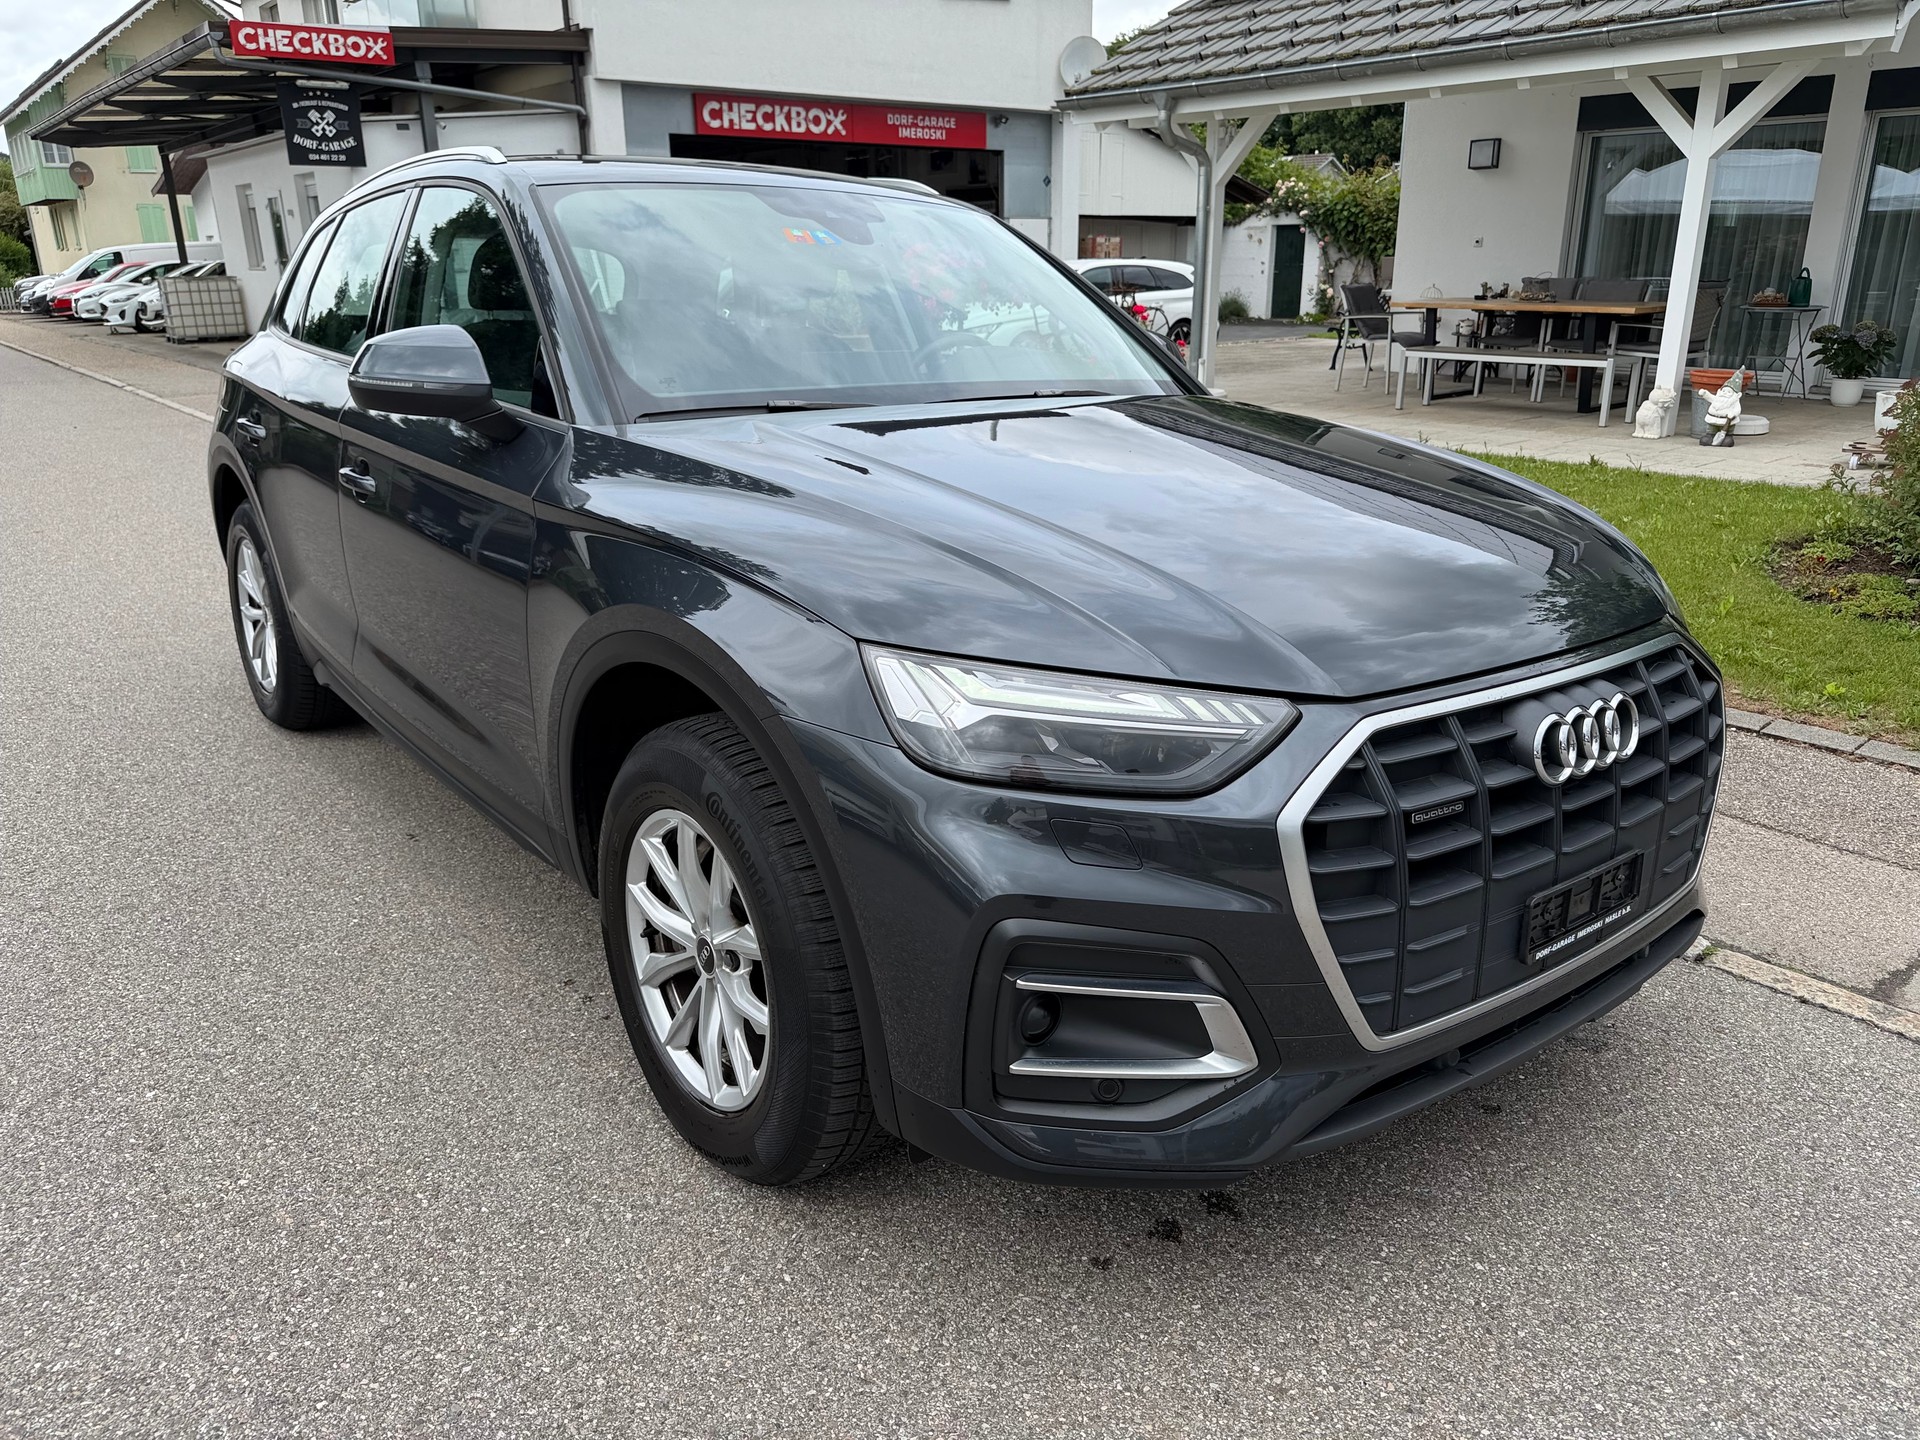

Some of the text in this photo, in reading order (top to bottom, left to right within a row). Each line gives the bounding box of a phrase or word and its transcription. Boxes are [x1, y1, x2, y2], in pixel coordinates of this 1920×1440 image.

[237, 26, 388, 61] CHECKBOX
[702, 100, 847, 136] CHECKBOX
[886, 113, 957, 129] DORF-GARAGE
[293, 133, 358, 151] DORF-GARAGE
[898, 126, 946, 141] IMEROSKI
[1415, 804, 1463, 821] quattro
[1535, 933, 1576, 960] DORF-GARAGE
